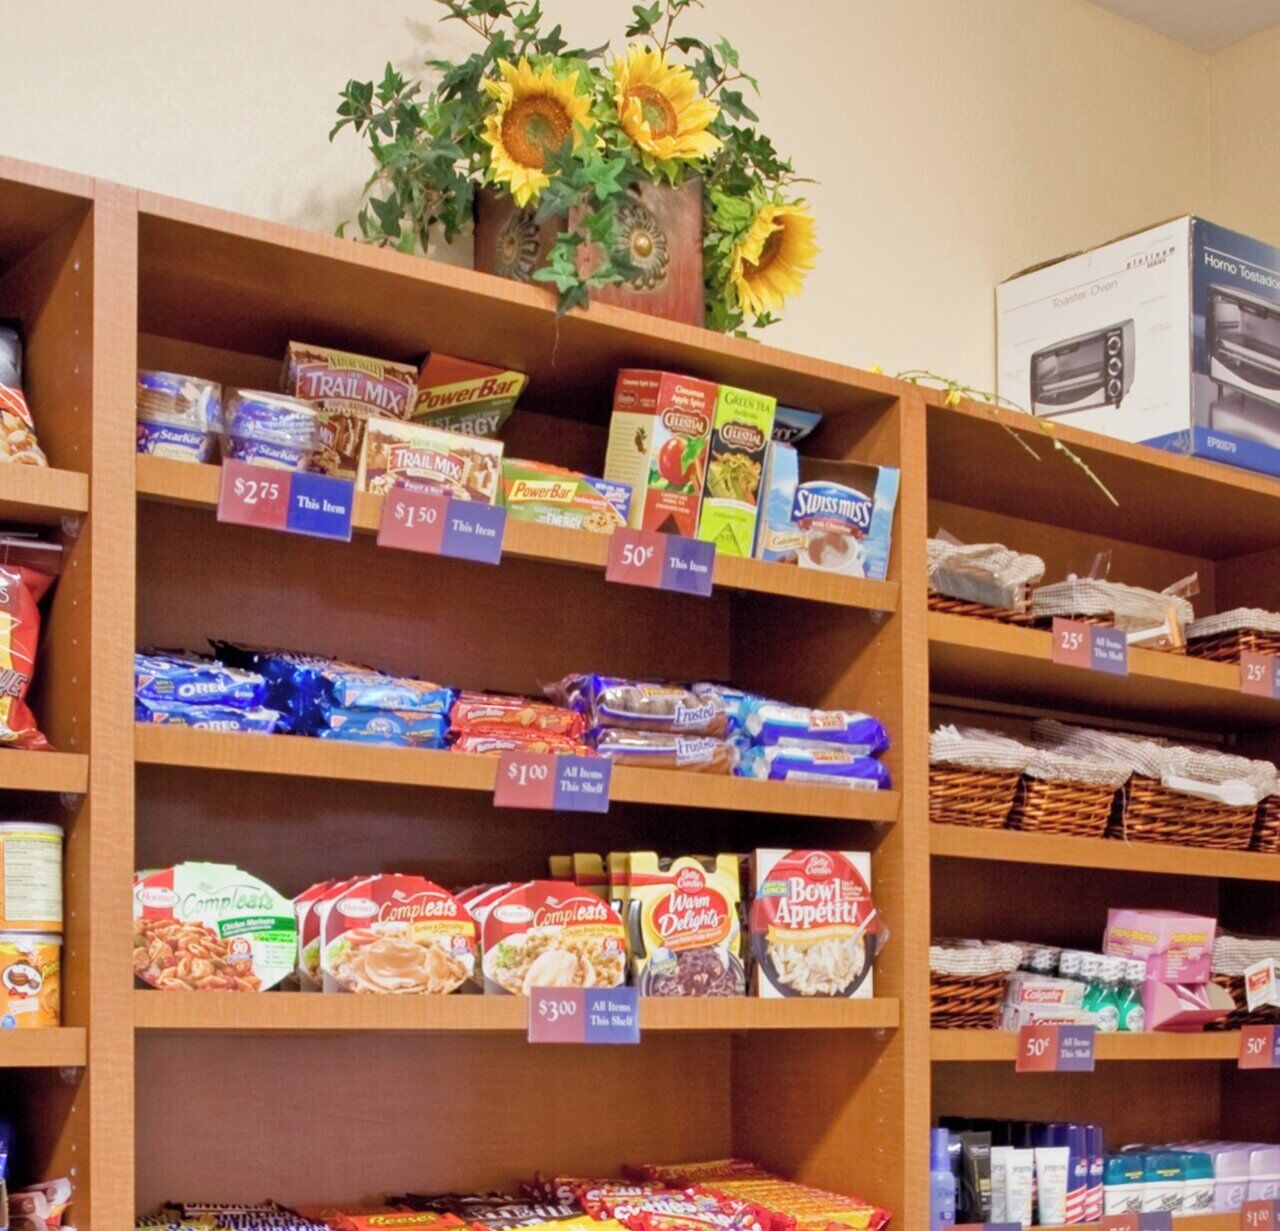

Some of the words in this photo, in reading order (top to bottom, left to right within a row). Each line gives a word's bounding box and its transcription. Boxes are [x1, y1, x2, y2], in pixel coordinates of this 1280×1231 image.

[1203, 253, 1237, 274] Horno
[1050, 286, 1088, 309] Toaster
[1090, 279, 1118, 298] Oven
[306, 371, 362, 400] TRAIL
[364, 379, 402, 411] MIX
[413, 378, 520, 410] PowerBar
[723, 393, 749, 408] GREEN
[751, 400, 771, 414] TEA
[663, 413, 708, 435] CELESTIAL
[159, 429, 202, 446] StarKist
[393, 450, 433, 469] TRAIL
[434, 459, 461, 478] MIX
[513, 482, 575, 501] PowerBar
[297, 495, 320, 510] This
[322, 501, 346, 516] Item
[452, 519, 475, 533] This
[477, 524, 496, 537] Item
[670, 557, 688, 570] This
[690, 560, 708, 573] Item
[178, 681, 228, 698] OREO
[674, 704, 716, 723] Frosted
[563, 767, 578, 778] All
[579, 769, 604, 781] Items
[560, 781, 580, 792] This
[582, 782, 604, 794] Shelf
[788, 877, 843, 904] Bowl
[377, 896, 457, 924] Compleats
[668, 893, 711, 913] Warm
[774, 898, 858, 925] Appétit!
[533, 906, 609, 928] Compleats
[658, 910, 727, 937] Delights
[1024, 989, 1062, 1002] Colgate
[593, 1002, 606, 1013] All
[608, 1002, 631, 1013] Items
[590, 1015, 611, 1027] This
[612, 1015, 633, 1027] Shelf
